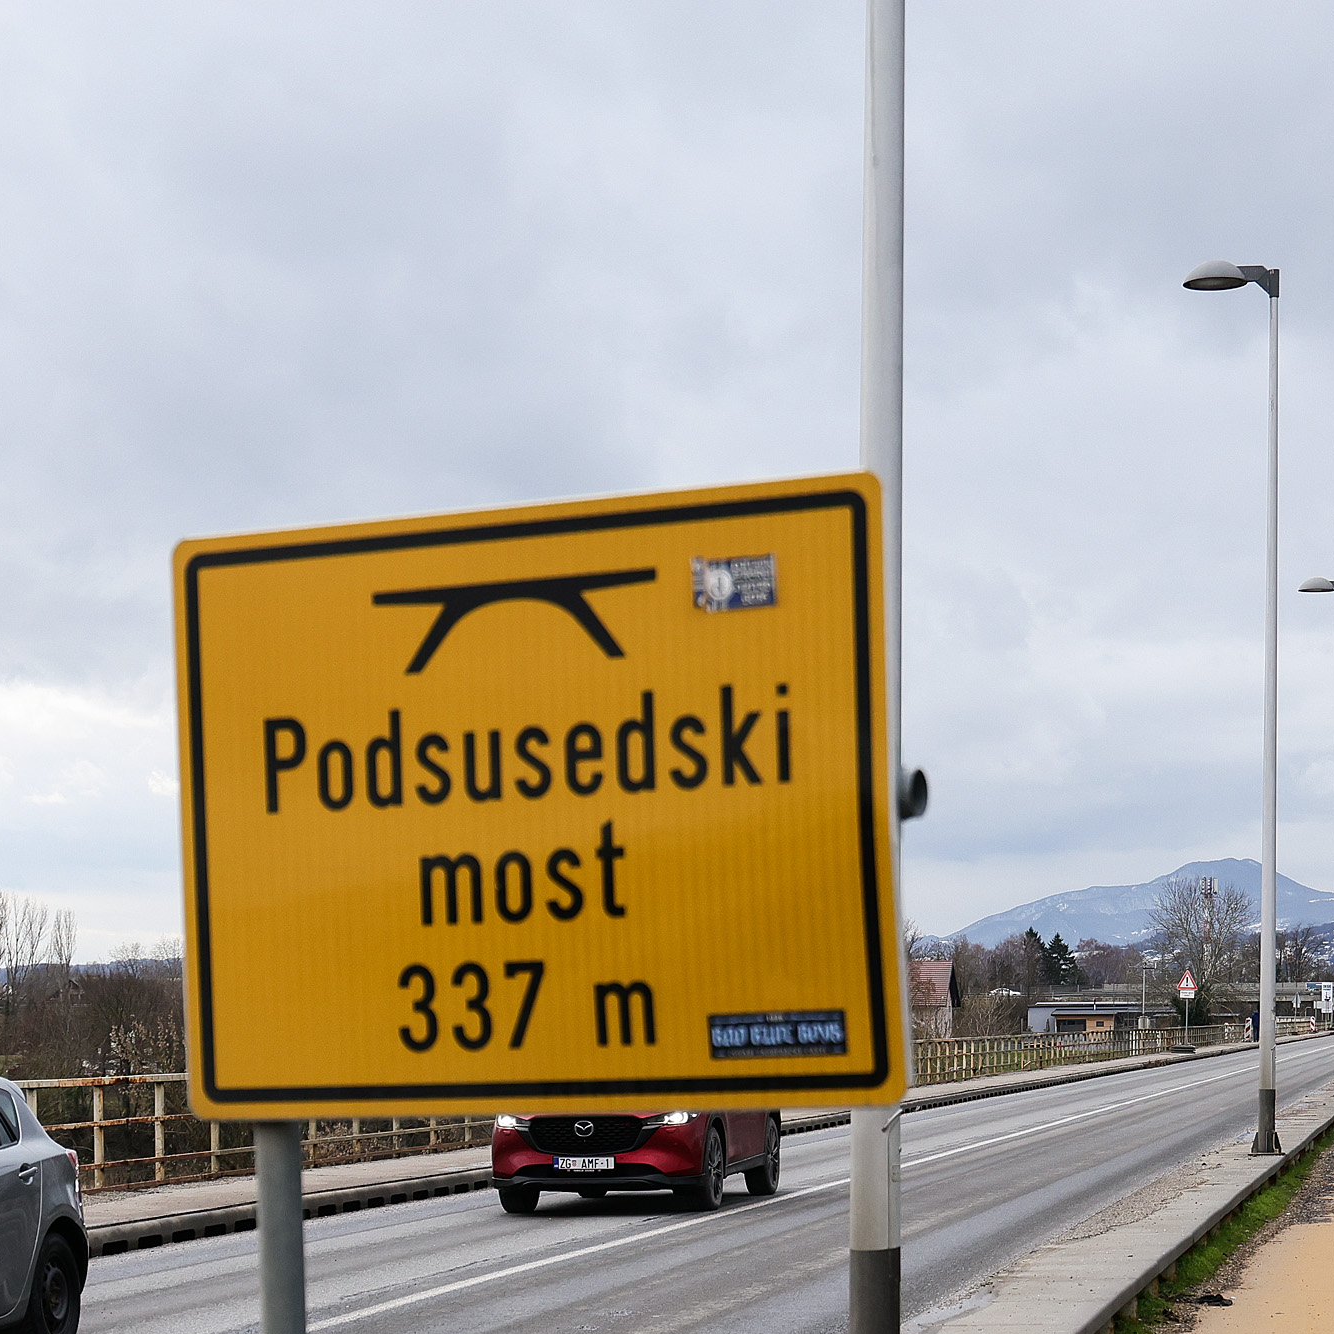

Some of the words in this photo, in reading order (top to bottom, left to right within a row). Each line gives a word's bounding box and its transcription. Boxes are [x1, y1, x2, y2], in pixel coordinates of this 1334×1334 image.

[262, 682, 792, 814] Podsusedski
[419, 819, 627, 927] most
[397, 959, 546, 1054] 337
[592, 978, 658, 1048] m
[560, 1158, 571, 1169] ZG
